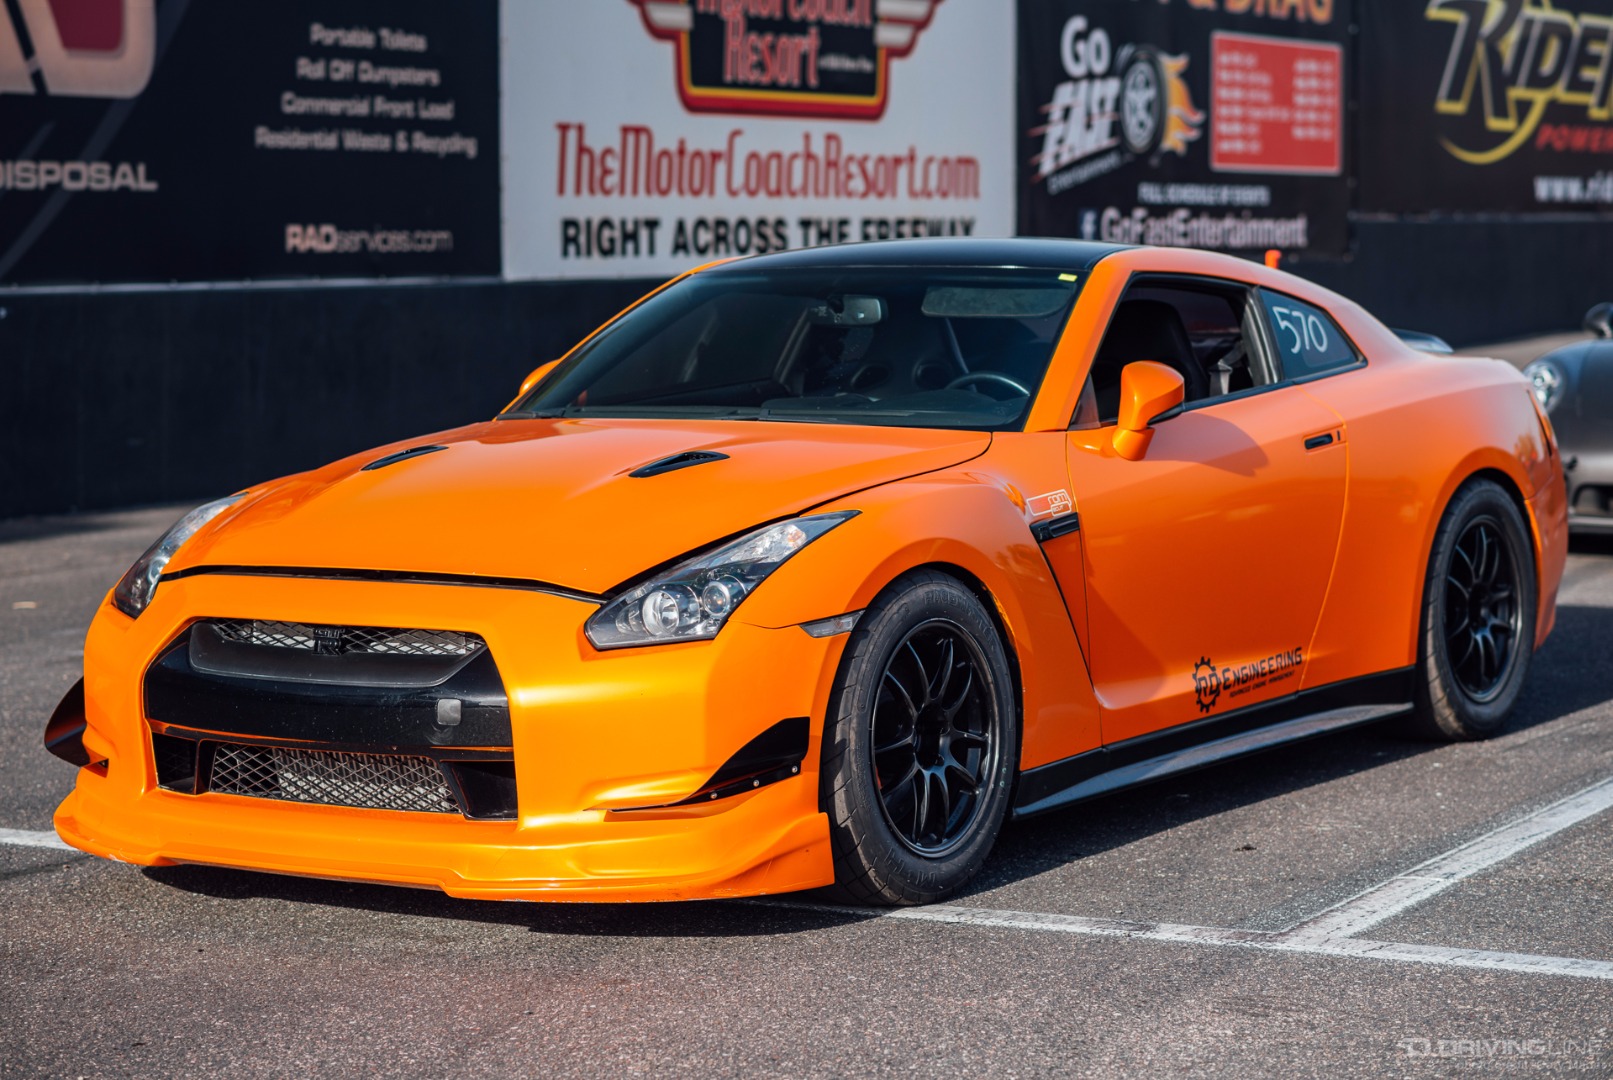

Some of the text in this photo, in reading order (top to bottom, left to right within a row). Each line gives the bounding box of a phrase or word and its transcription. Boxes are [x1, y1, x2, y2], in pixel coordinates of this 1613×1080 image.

[310, 23, 427, 51] Portable Toilets
[1061, 15, 1110, 78] Go
[297, 57, 440, 87] Roll Off Dumpsters
[281, 91, 454, 120] Commercial Front Load
[255, 126, 337, 150] Residential
[342, 129, 391, 151] Waste
[412, 131, 478, 158] Recycling
[0, 160, 159, 191] ISPOSAL
[285, 223, 453, 253] RADservices.com
[561, 218, 661, 258] RIGHT
[671, 218, 788, 256] ACROSS
[798, 219, 850, 247] THE
[1272, 306, 1328, 354] 570
[1221, 646, 1302, 690] ENGINEERING
